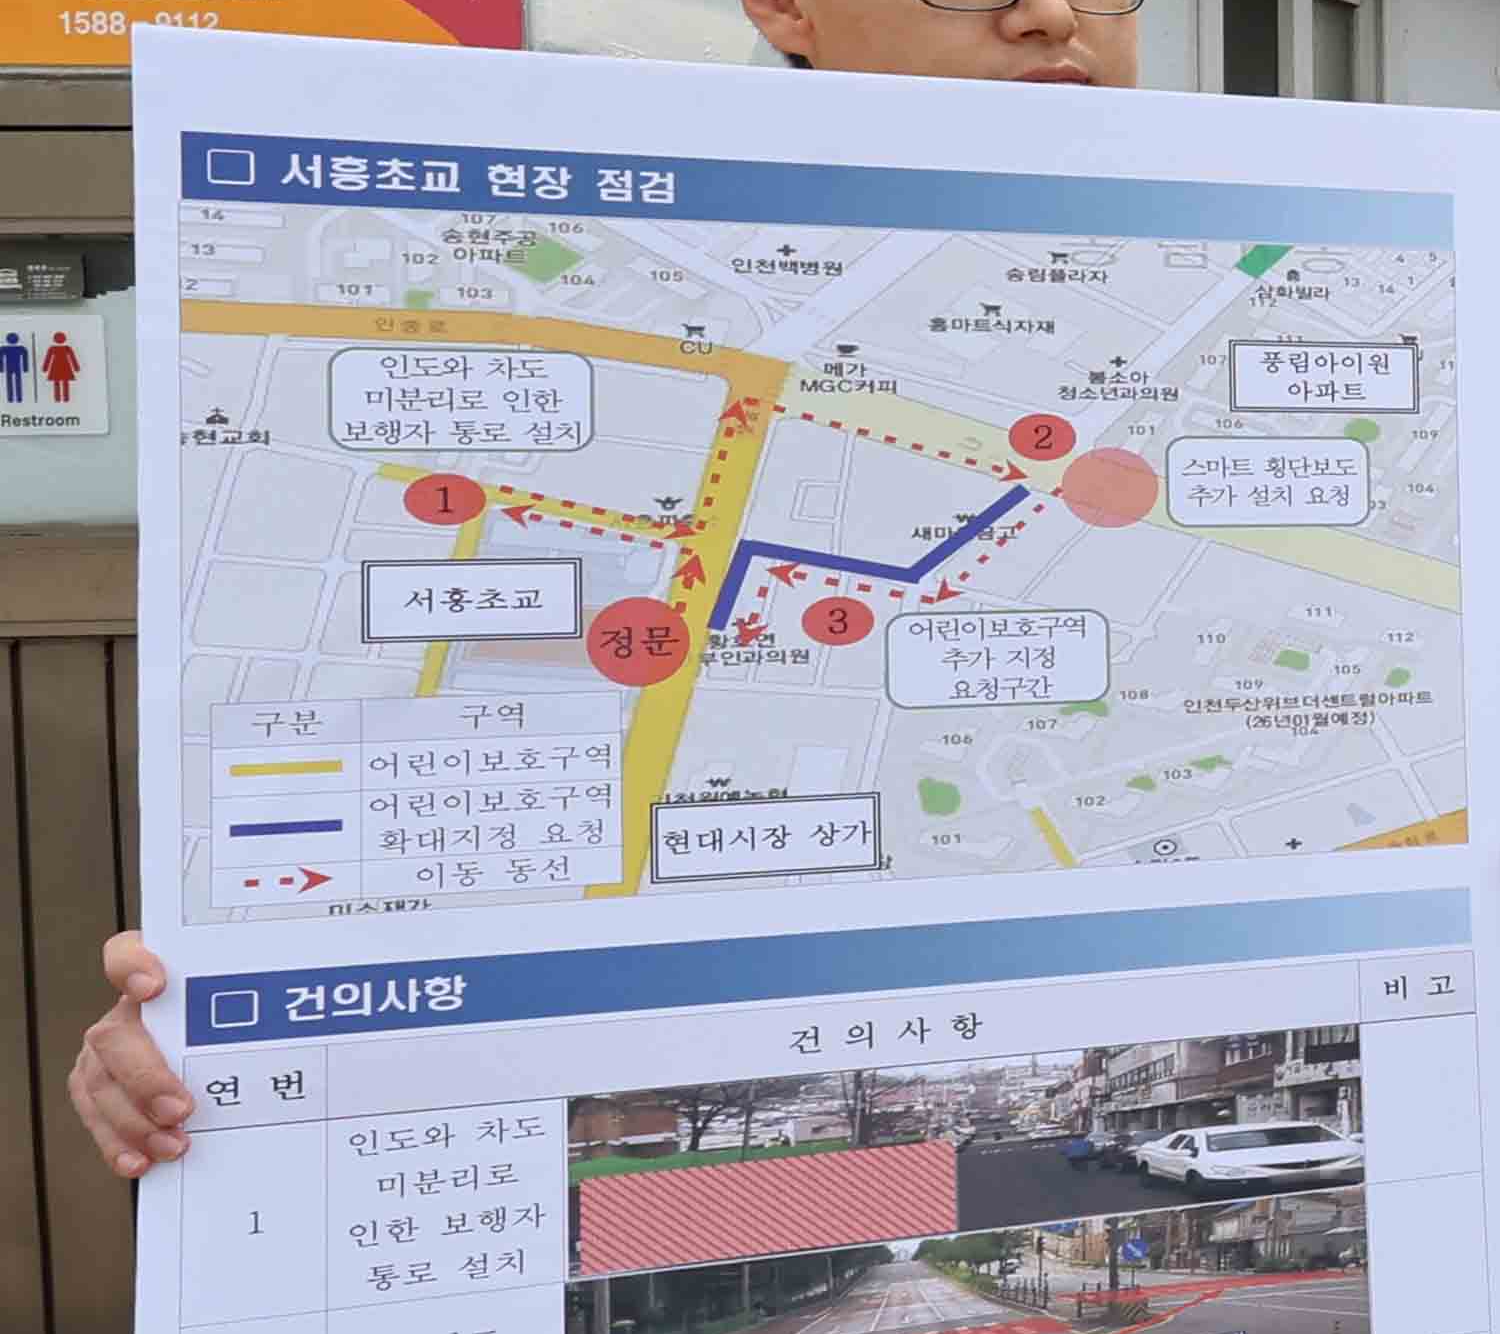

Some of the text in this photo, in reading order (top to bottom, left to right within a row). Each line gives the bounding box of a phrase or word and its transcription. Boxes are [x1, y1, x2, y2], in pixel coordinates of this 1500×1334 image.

[281, 153, 676, 203] 서흥초교 현장 점검
[402, 253, 439, 265] 102
[453, 248, 528, 265] 아파트
[731, 258, 843, 277] 인천백병원
[679, 341, 713, 355] CU
[380, 355, 548, 381] 인도와 차도
[1263, 351, 1391, 375] 풍림아이원
[365, 387, 563, 414] 미분리로 인한
[1287, 381, 1367, 403] 아파트
[1, 414, 80, 427] Restroom
[341, 420, 583, 445] 보행자 통로 설치
[181, 429, 270, 446] 현교회
[1033, 424, 1053, 450] 2
[1181, 455, 1358, 478] 스마트 횡단보도
[436, 486, 454, 513] 1
[1186, 484, 1351, 507] 추가 설치 요청
[828, 608, 849, 635] 3
[909, 615, 1087, 642] 어린이보호구역
[600, 625, 680, 659] 정문
[941, 645, 1056, 670] 추가 지정
[949, 675, 1053, 700] 요청구간
[251, 709, 323, 738] 구분
[459, 702, 524, 730] 구역
[369, 743, 612, 778] 어린이보호구역
[369, 783, 612, 819] 어린이보호구역
[379, 818, 604, 855] 확대지정 요청
[663, 820, 873, 855] 현대시장 상가
[416, 855, 571, 889] 이동 동선
[285, 975, 468, 1022] 건의사항
[349, 1115, 546, 1157] 인도와 차도
[376, 1162, 520, 1198] 미분리로
[248, 1210, 265, 1236] 1
[348, 1203, 547, 1248] 인한 보행자
[367, 1249, 526, 1292] 통로 설치
